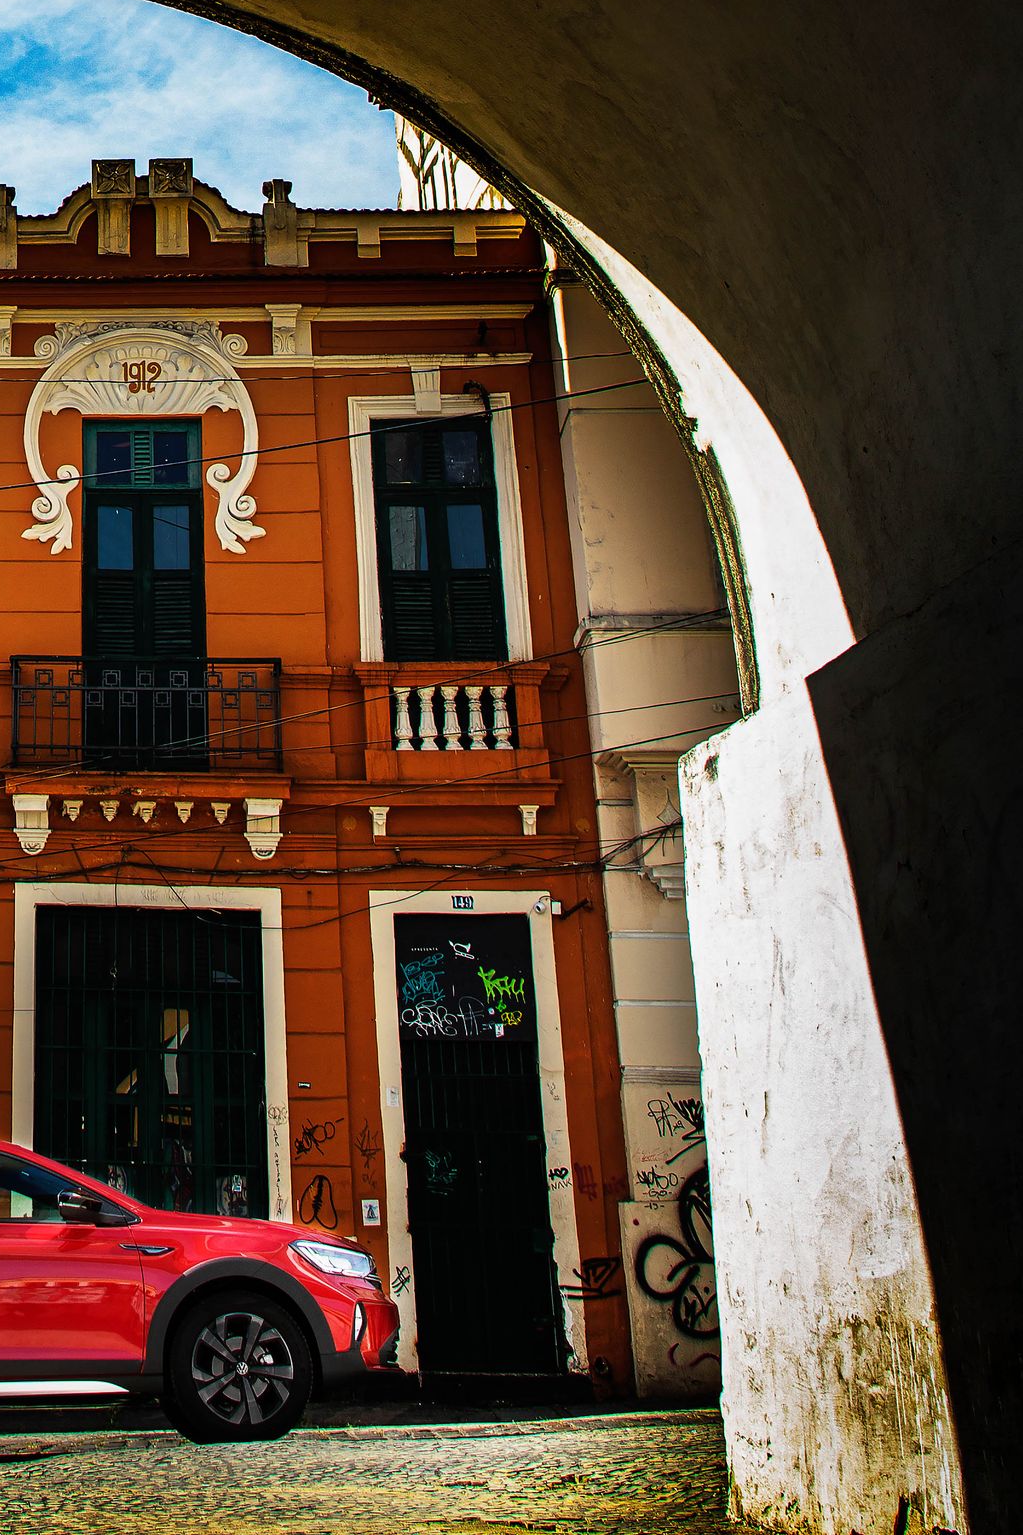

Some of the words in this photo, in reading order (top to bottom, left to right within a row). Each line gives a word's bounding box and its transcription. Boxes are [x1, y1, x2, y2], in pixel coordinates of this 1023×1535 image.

[122, 360, 162, 394] 1912
[453, 896, 473, 909] 149
[236, 1362, 249, 1376] VW
